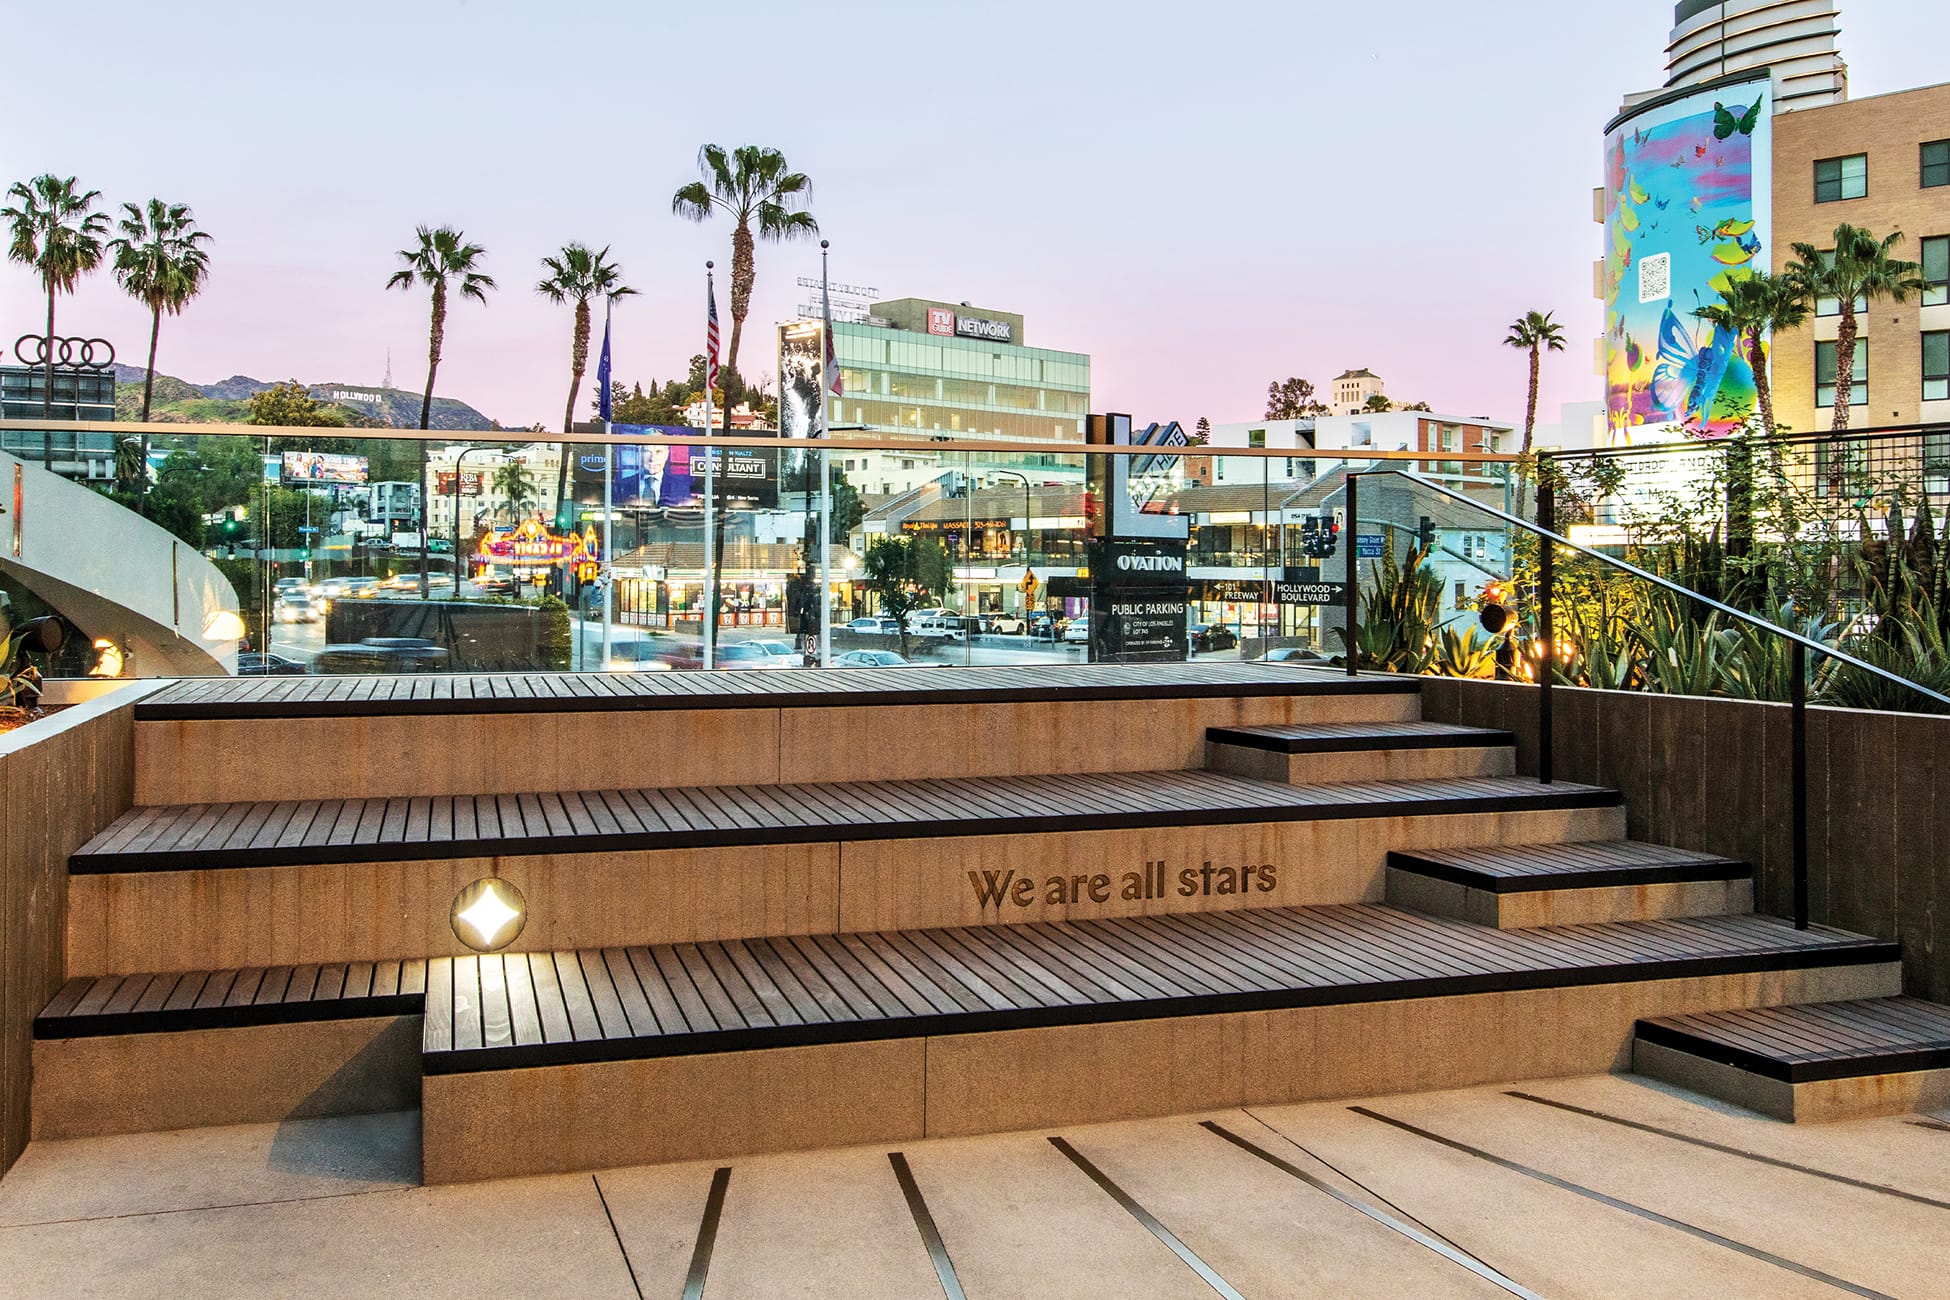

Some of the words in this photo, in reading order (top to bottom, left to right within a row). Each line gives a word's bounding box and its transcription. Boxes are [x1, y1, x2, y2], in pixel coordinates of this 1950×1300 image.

[932, 311, 951, 325] TV
[932, 323, 953, 334] GUIDE
[958, 319, 1011, 338] NETWORK
[333, 390, 382, 402] HOLLYWOOD
[1117, 552, 1182, 571] OVATION
[1224, 583, 1236, 591] 101
[1277, 584, 1330, 593] HOLLYWOOD
[1225, 591, 1259, 600] FREEWAY
[1281, 593, 1330, 602] BOULEVARD
[1111, 604, 1144, 615] PUBLIC
[1145, 603, 1184, 614] PARKING
[967, 869, 1035, 910] We
[1045, 873, 1111, 905] are
[1121, 860, 1165, 901] all
[1177, 861, 1278, 897] stars
